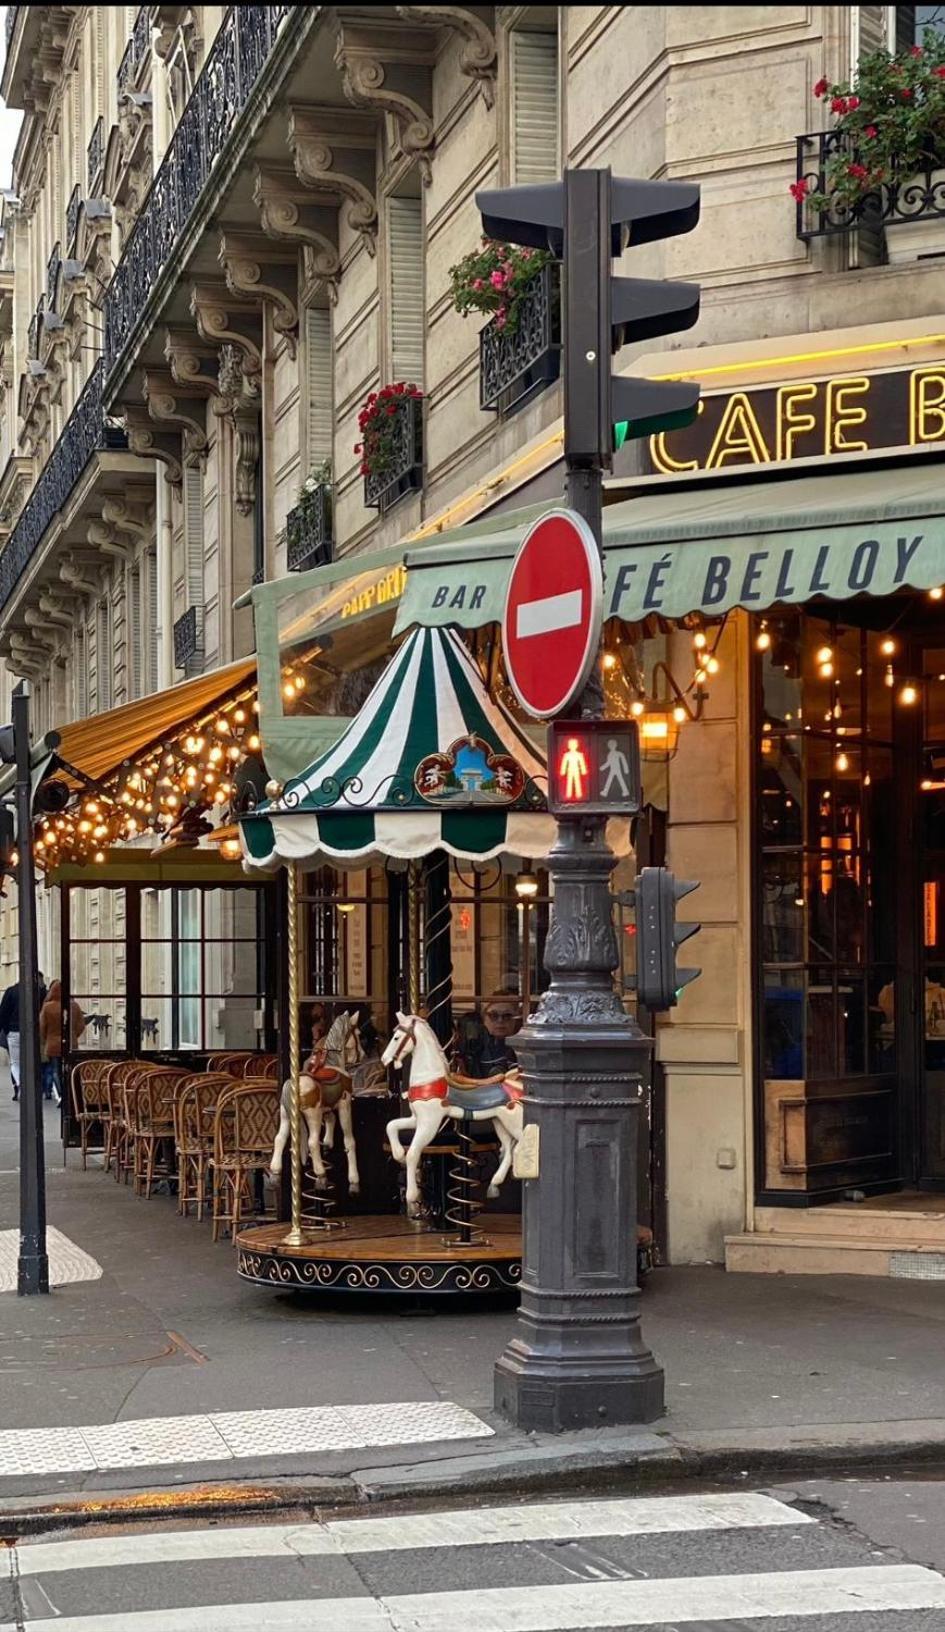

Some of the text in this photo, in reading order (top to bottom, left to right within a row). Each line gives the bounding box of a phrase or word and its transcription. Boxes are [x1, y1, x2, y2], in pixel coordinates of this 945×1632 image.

[650, 377, 870, 474] CAFE
[431, 584, 487, 610] BAR
[610, 553, 672, 614] FÉ
[701, 535, 924, 606] BELLOY
